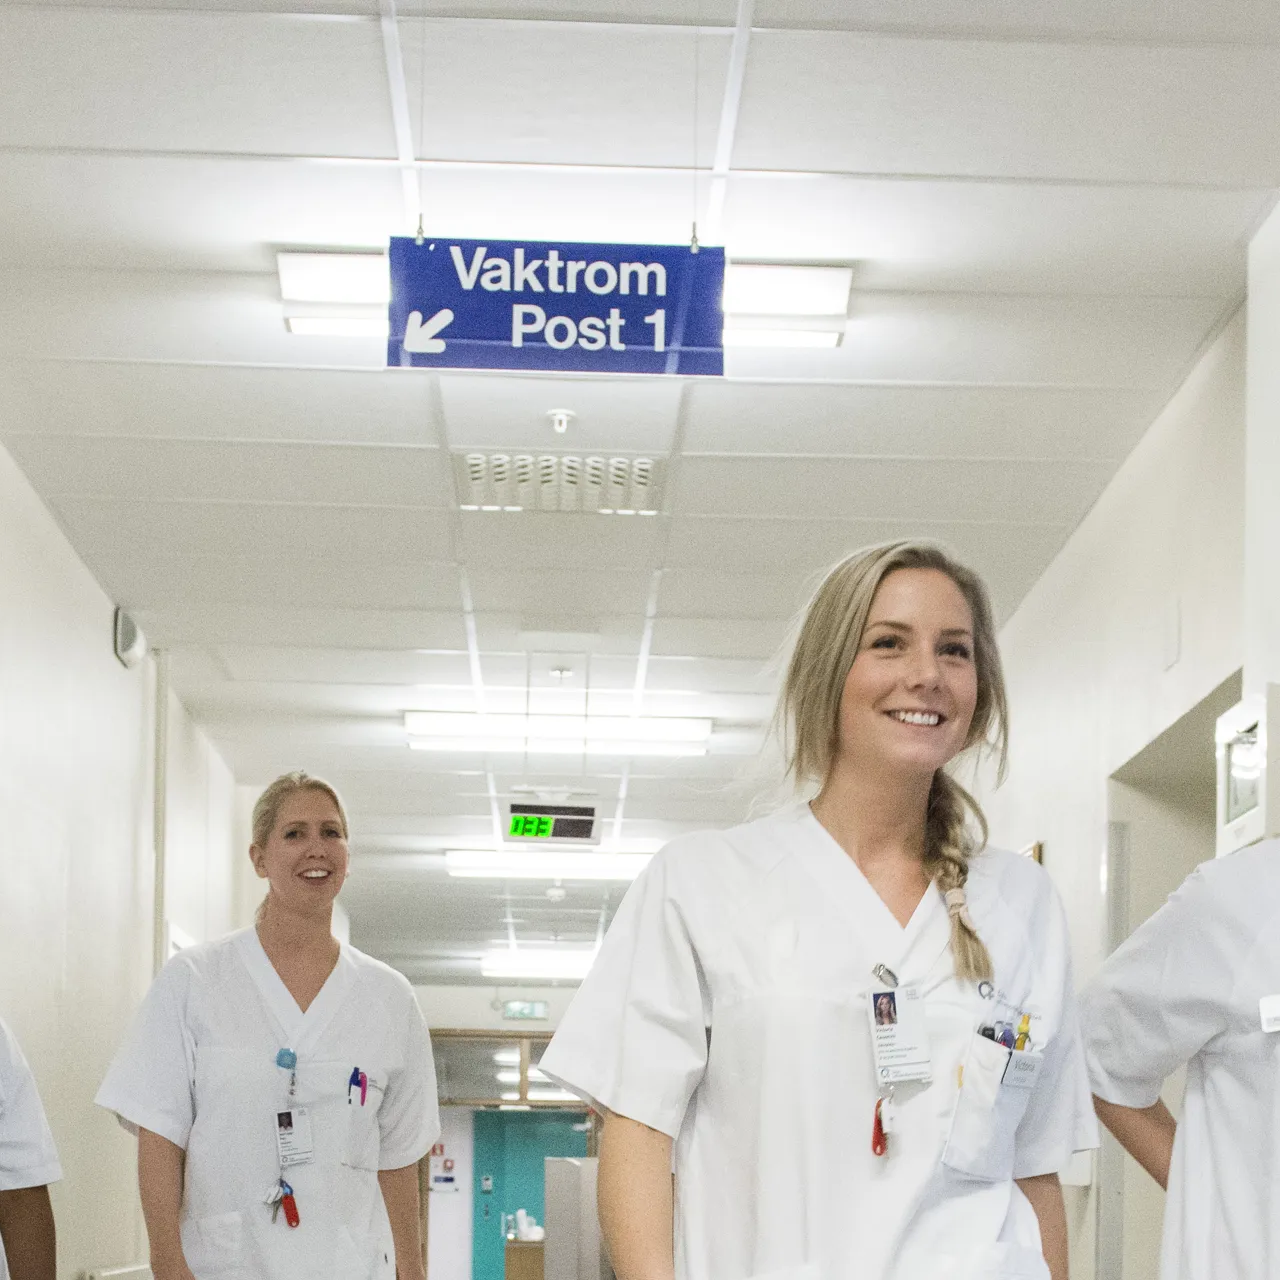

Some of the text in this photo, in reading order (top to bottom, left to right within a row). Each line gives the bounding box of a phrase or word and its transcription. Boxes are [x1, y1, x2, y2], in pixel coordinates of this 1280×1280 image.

[450, 245, 667, 297] Vaktrom
[511, 304, 666, 353] Post 1
